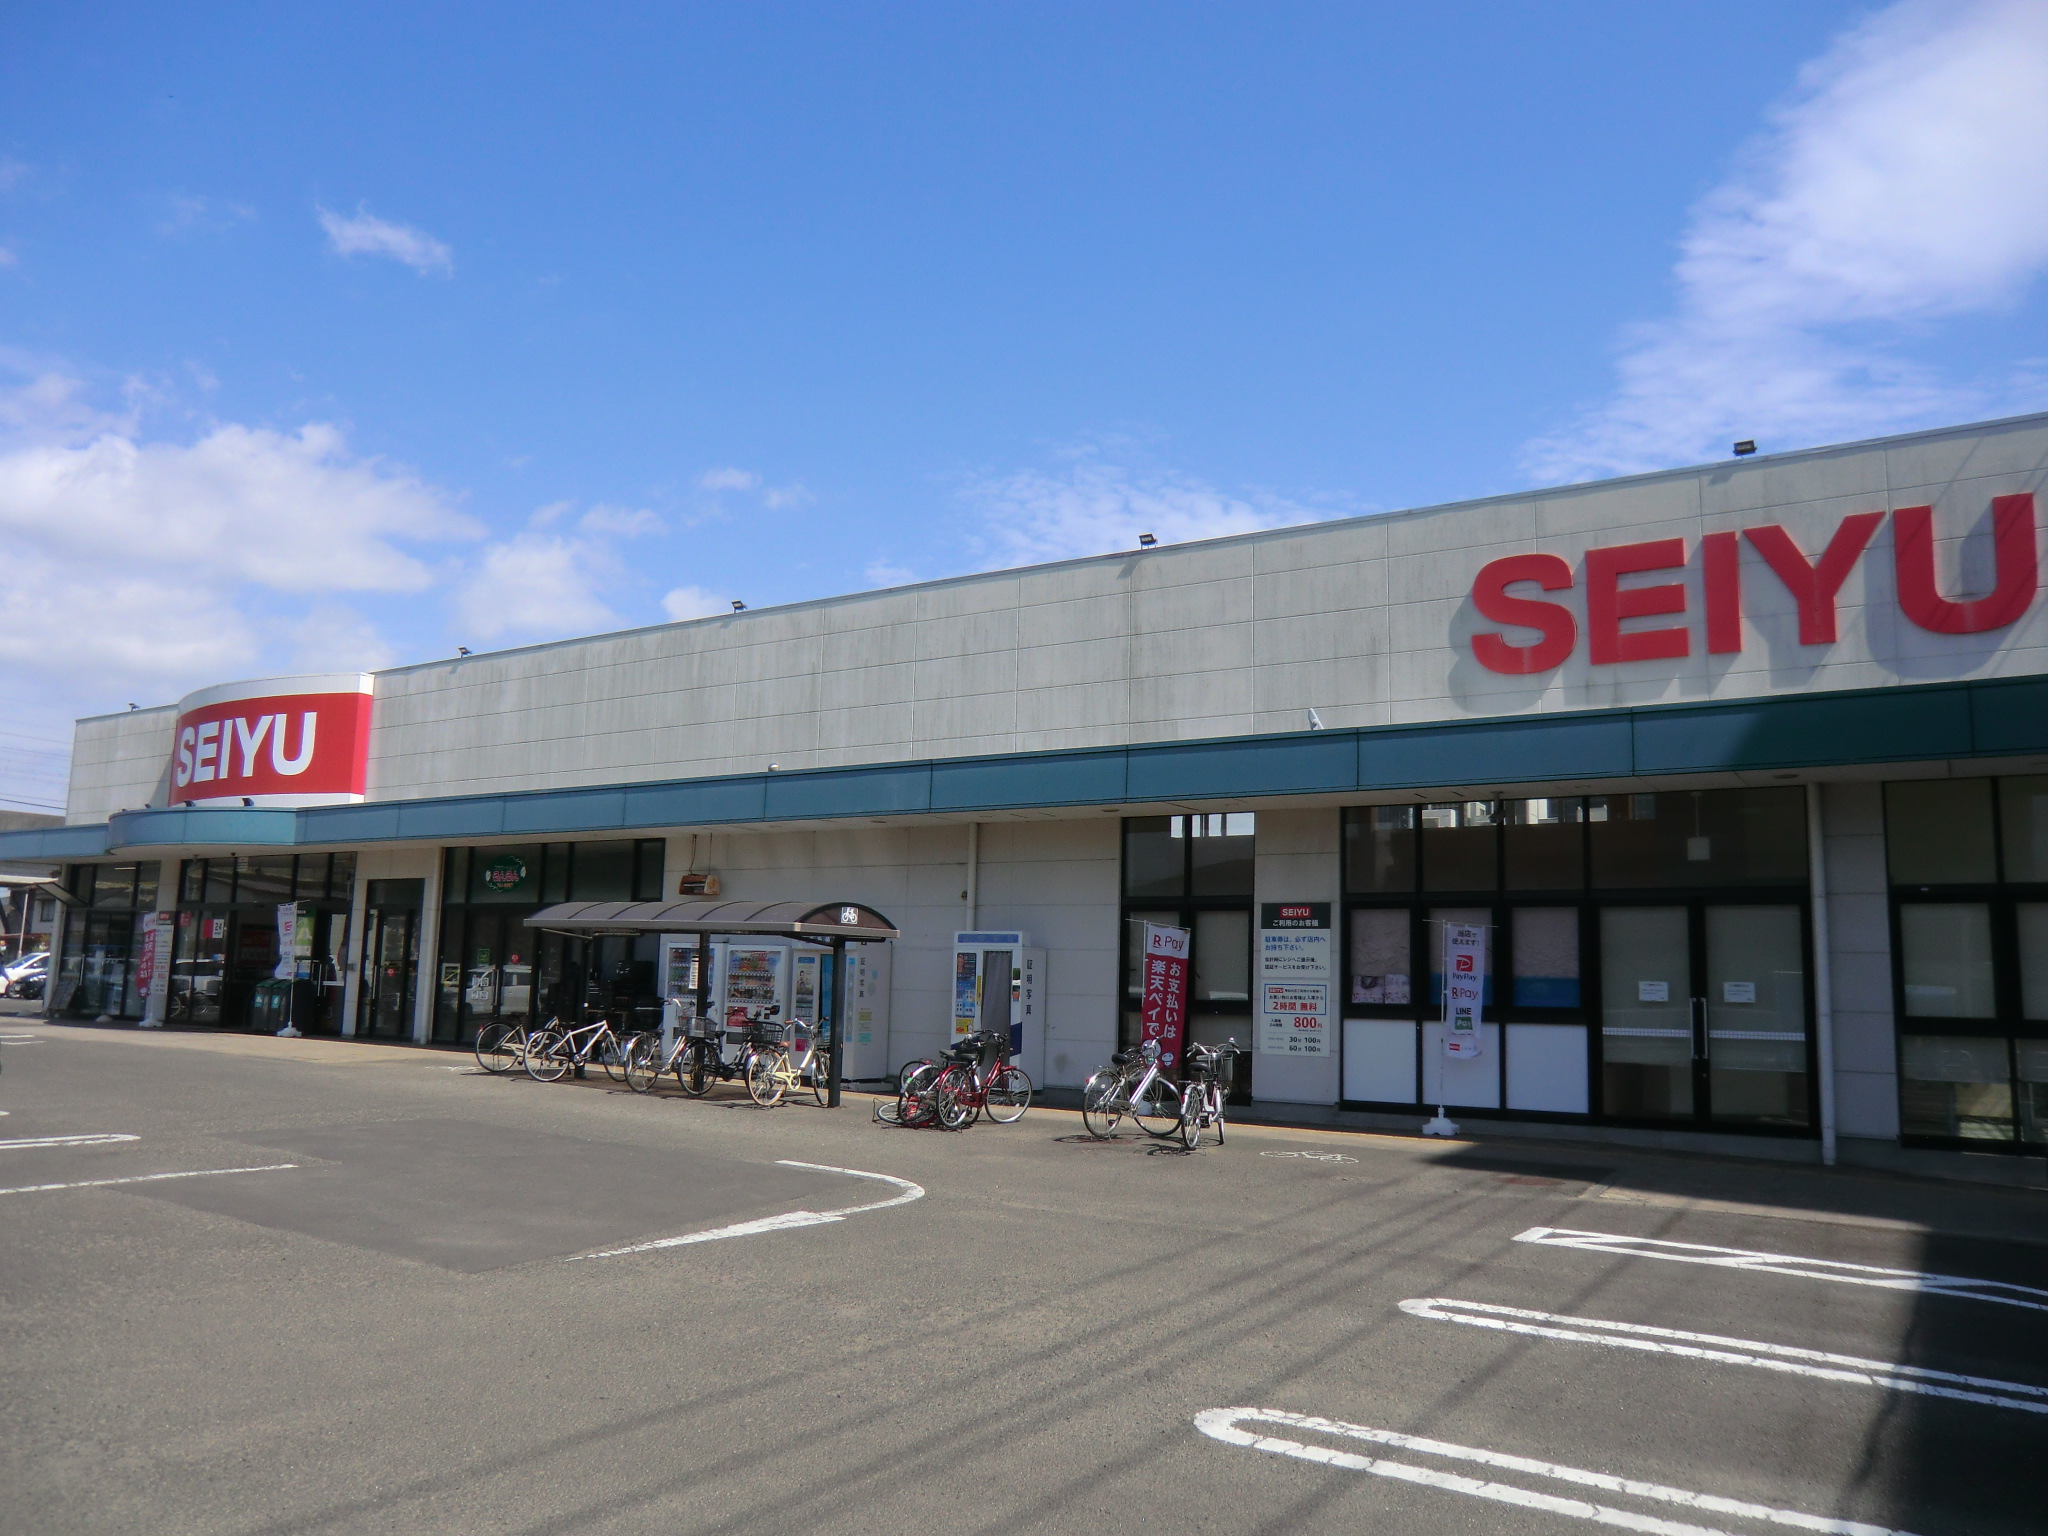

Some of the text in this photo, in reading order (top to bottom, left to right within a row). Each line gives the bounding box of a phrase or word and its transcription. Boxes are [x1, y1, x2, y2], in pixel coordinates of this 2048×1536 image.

[1471, 492, 2038, 675] SEIYU
[176, 711, 318, 788] SEIYU
[1282, 908, 1309, 916] SEIYU
[214, 922, 224, 931] 24
[1272, 919, 1319, 927] ご利用のお客様
[1457, 929, 1477, 938] 当店で
[1164, 935, 1184, 951] Pay
[1452, 973, 1478, 982] PayPay
[1025, 959, 1033, 1015] 証明写真
[1146, 959, 1166, 1036] 楽天ペイで
[1163, 962, 1181, 1039] お支払いは
[1460, 989, 1479, 1001] Pay
[1272, 1001, 1318, 1012] 2時間 無料
[1455, 1007, 1472, 1015] LINE
